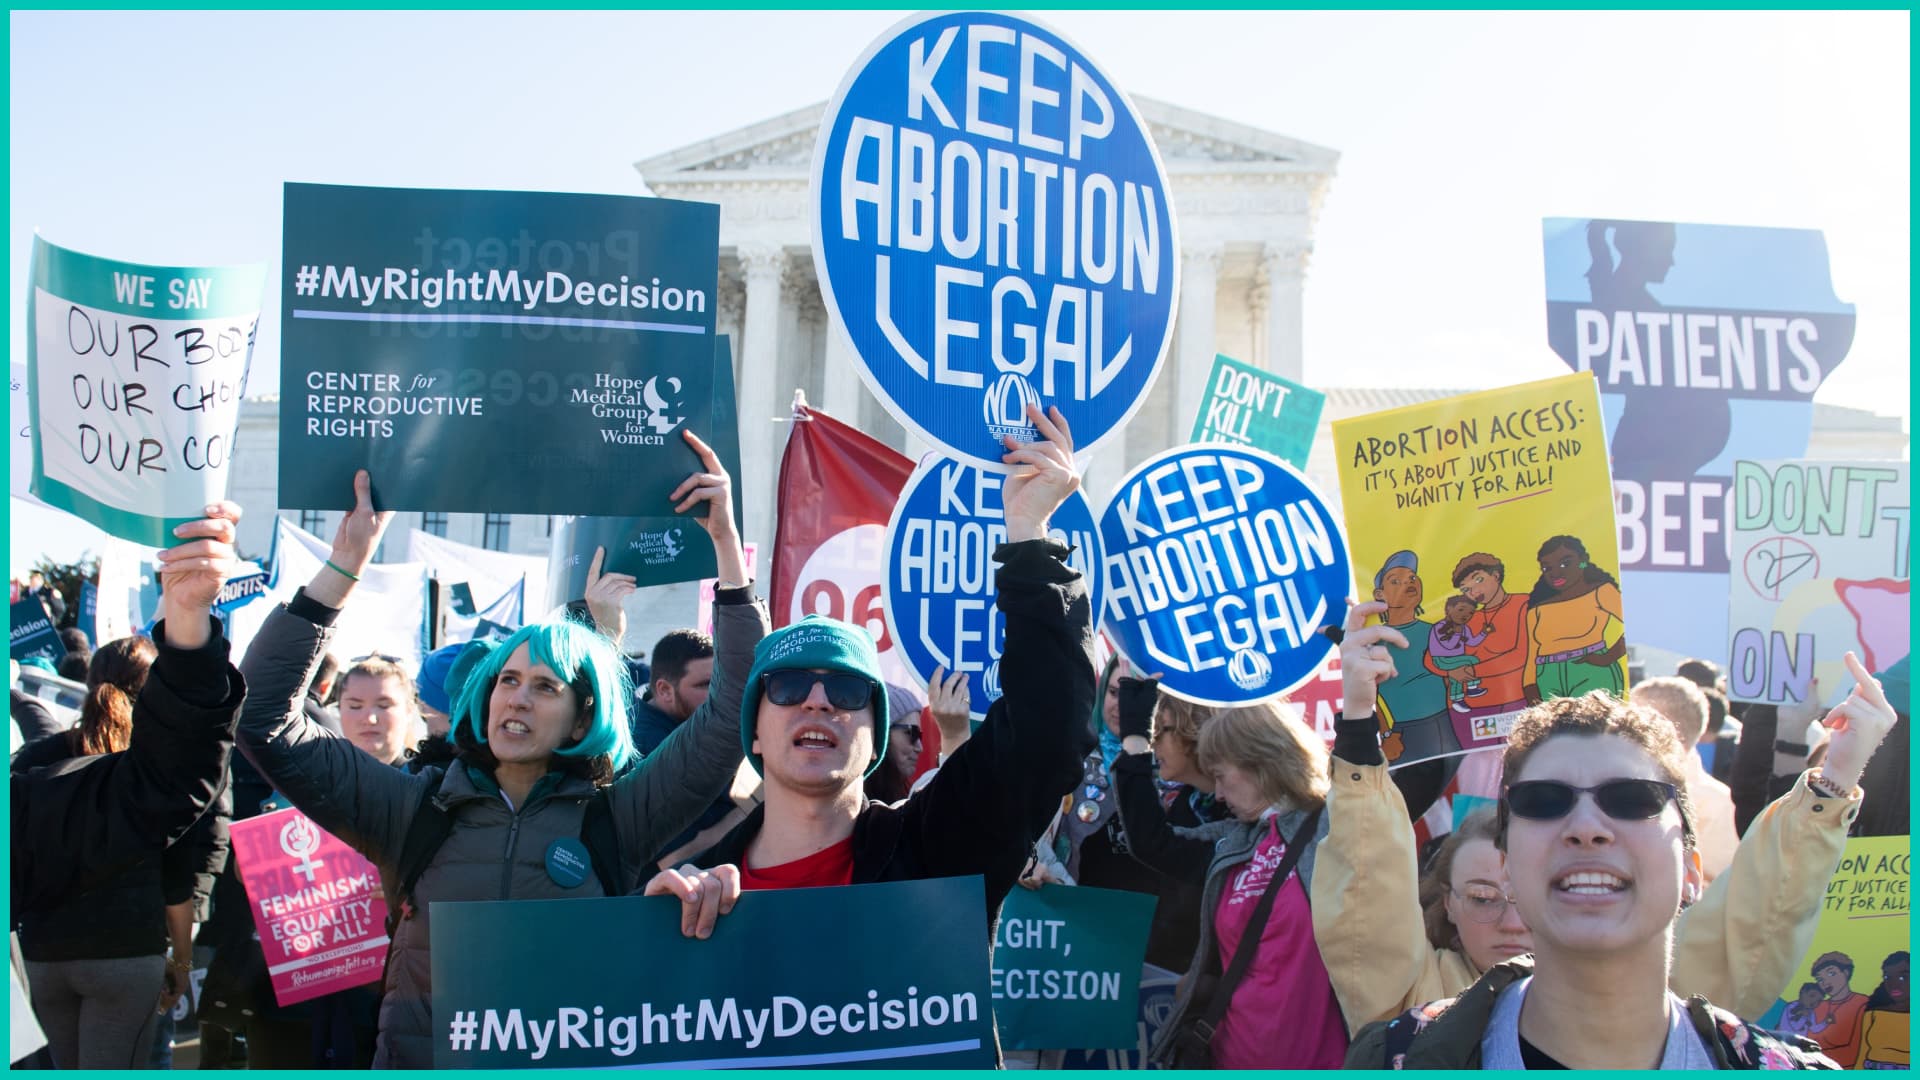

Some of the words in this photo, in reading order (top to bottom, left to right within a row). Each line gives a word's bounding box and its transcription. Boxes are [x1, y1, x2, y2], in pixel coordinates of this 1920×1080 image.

[908, 24, 1115, 160] KEEP
[840, 116, 1160, 295] ABORTION
[114, 271, 155, 308] WE
[168, 277, 213, 309] SAY
[294, 264, 706, 313] #MyRightMyDecision
[68, 305, 171, 372] OUR
[876, 253, 1132, 401] LEGAL
[1575, 309, 1822, 394] PATIENTS
[73, 374, 153, 416] OUR
[306, 371, 401, 392] CENTER
[406, 373, 437, 393] for
[306, 393, 483, 417] REPRODUCTIVE
[570, 388, 641, 406] Medical
[595, 373, 644, 395] Hope
[1214, 363, 1292, 419] DON'T
[306, 417, 394, 439] RIGHTS
[591, 404, 649, 425] Group
[600, 429, 665, 446] Women
[625, 421, 646, 434] for
[1204, 396, 1253, 444] KILL
[1353, 418, 1478, 469] ABORTION
[1490, 400, 1585, 444] ACCESS:
[79, 423, 167, 475] OUR
[1364, 469, 1397, 492] IT'S
[1404, 457, 1461, 487] ABOUT
[1469, 446, 1540, 477] JUSTICE
[1547, 439, 1582, 462] AND
[939, 461, 1004, 520] KE
[1116, 455, 1265, 545] KEEP
[1396, 481, 1465, 511] DIGNITY
[1472, 475, 1510, 500] FOR
[1515, 465, 1553, 492] ALL!
[1735, 459, 1898, 538] DONT
[630, 538, 664, 550] Medical
[640, 532, 664, 541] Hope
[1617, 479, 1733, 567] BEF
[639, 546, 668, 555] Group
[644, 556, 676, 565] Women
[1105, 499, 1335, 622] ABORTION
[214, 574, 265, 605] ROFITS
[1138, 578, 1328, 674] LEGAL
[1730, 627, 1815, 704] ON
[260, 872, 376, 918] FEMINISM:
[1848, 896, 1876, 912] FOR
[1850, 879, 1908, 895] JUSTICE
[271, 898, 372, 942] EQUALITY
[282, 930, 326, 957] FOR
[449, 984, 979, 1061] #MyRightMyDecision
